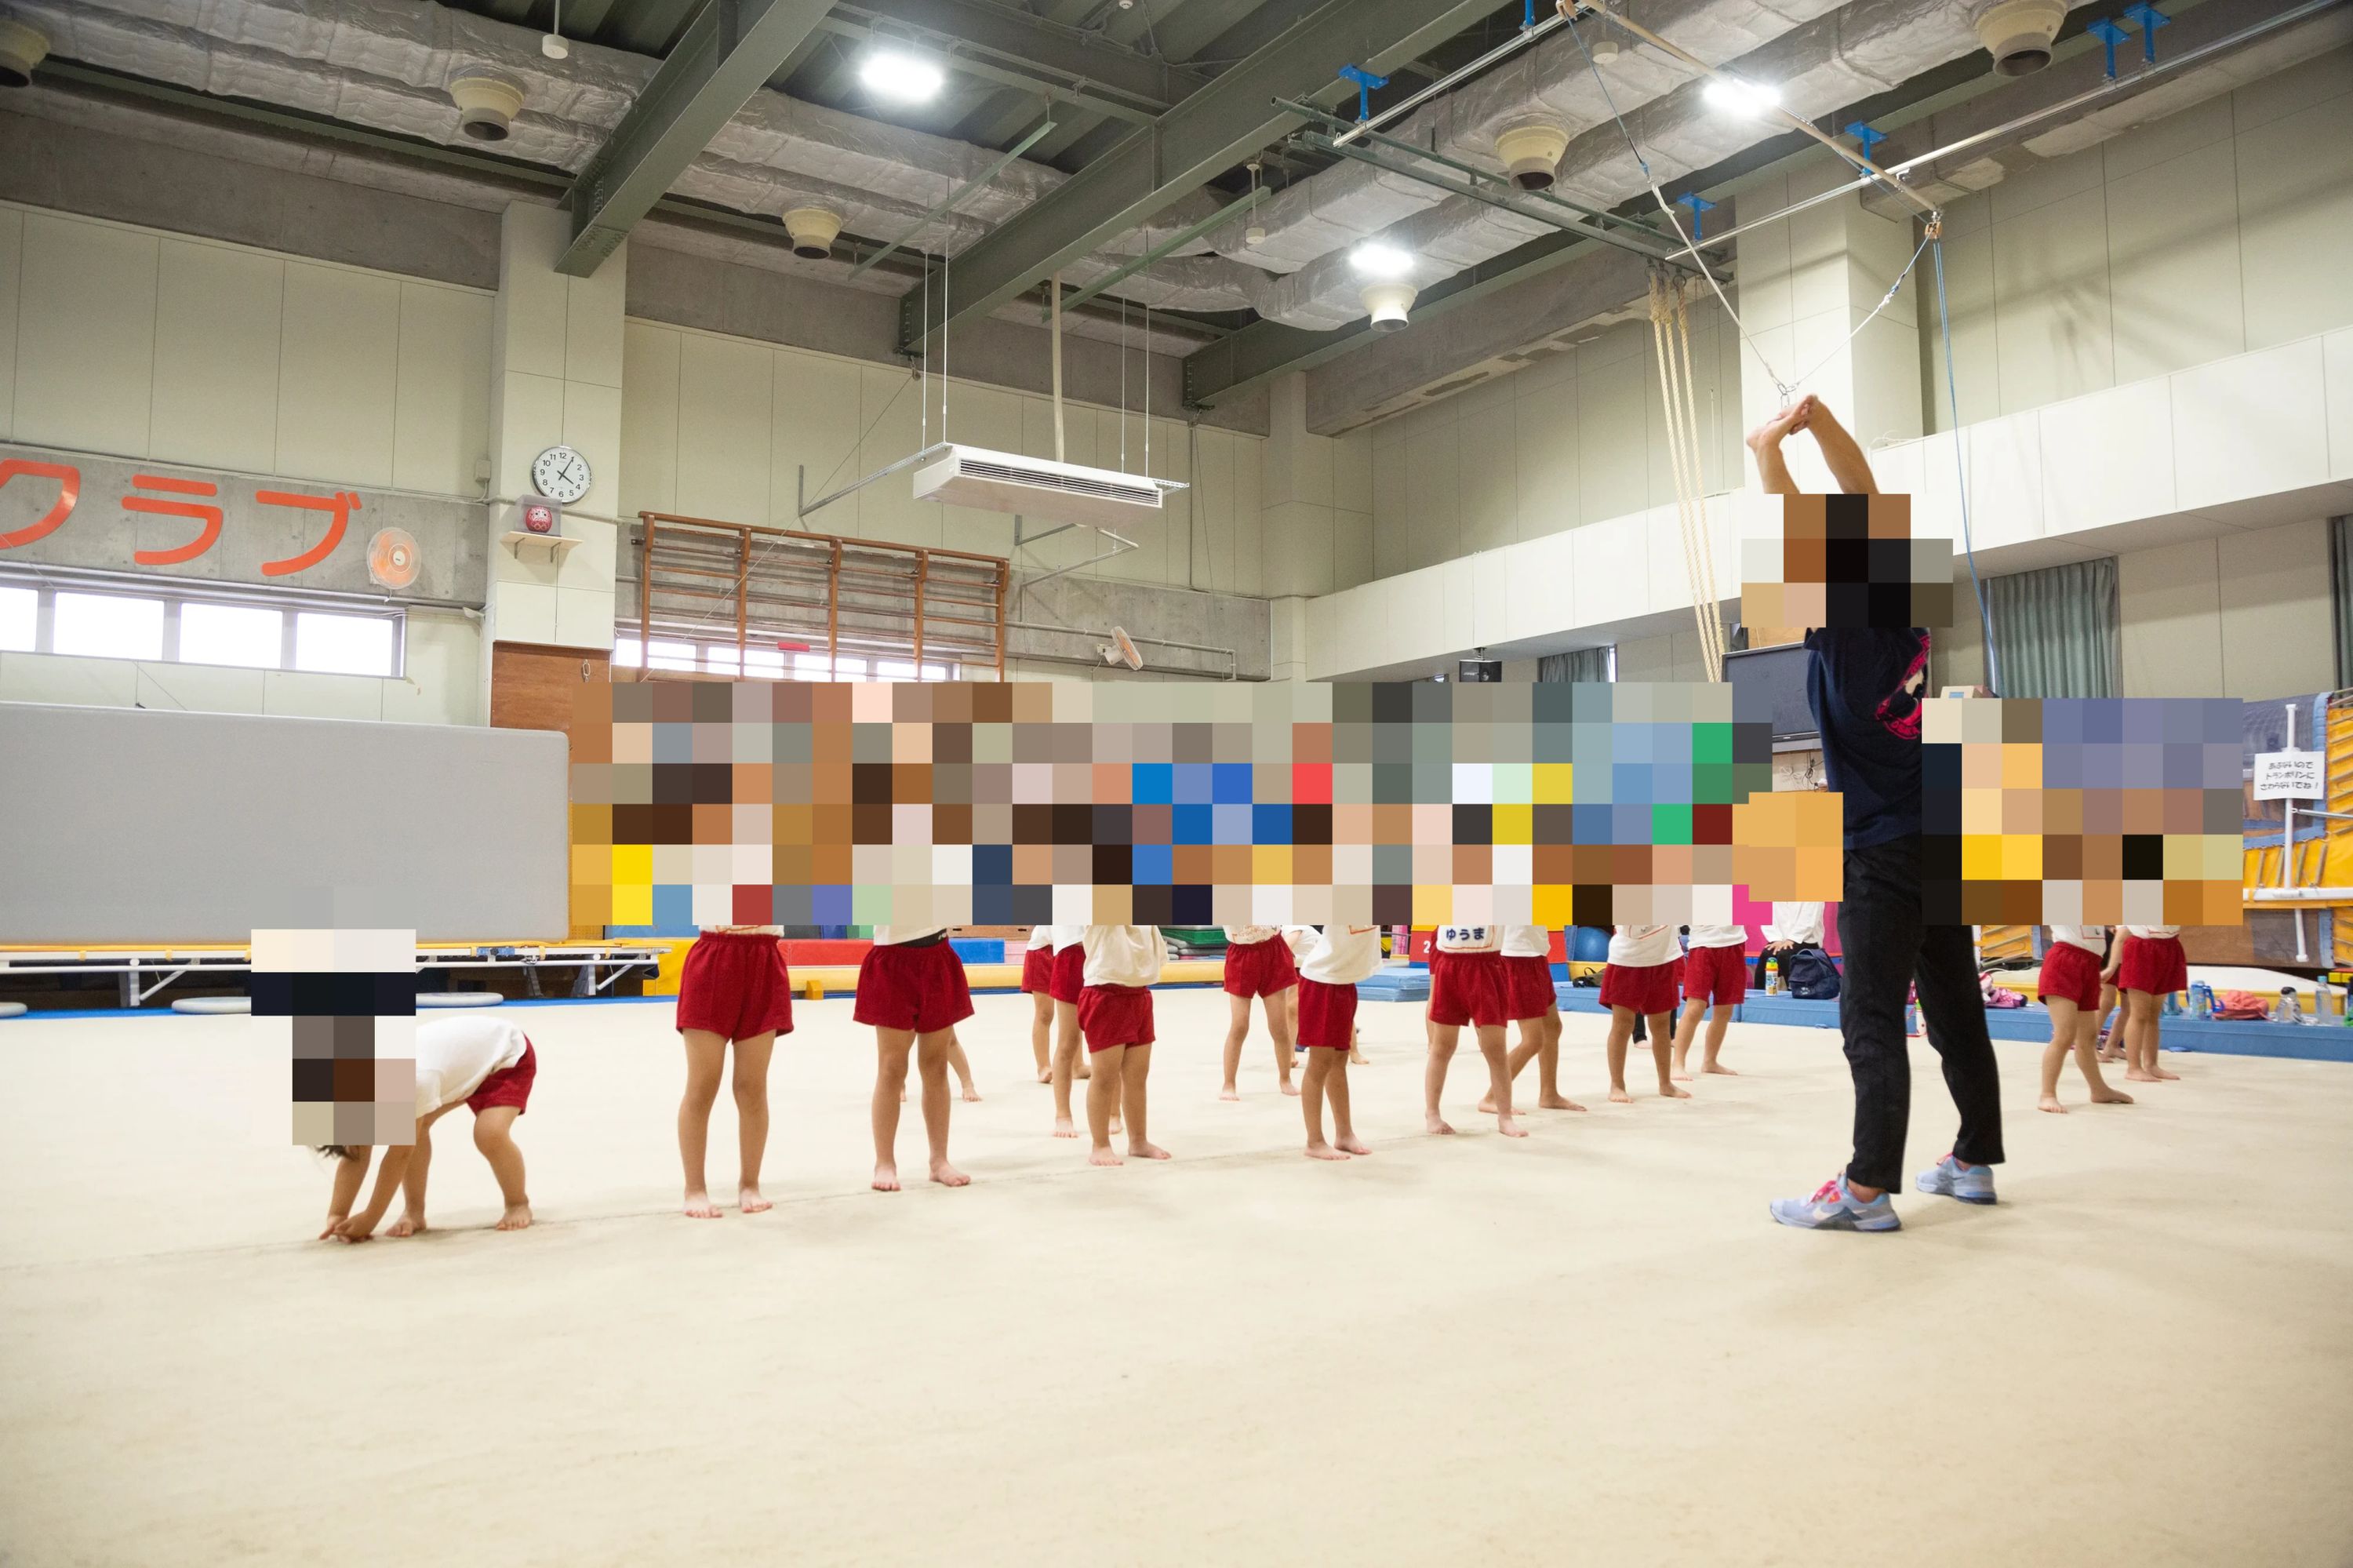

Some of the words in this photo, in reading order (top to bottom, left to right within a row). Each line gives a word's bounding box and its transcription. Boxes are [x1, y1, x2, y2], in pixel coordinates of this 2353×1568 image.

[1446, 927, 1485, 940] ゆうま
[1423, 940, 1431, 954] 2
